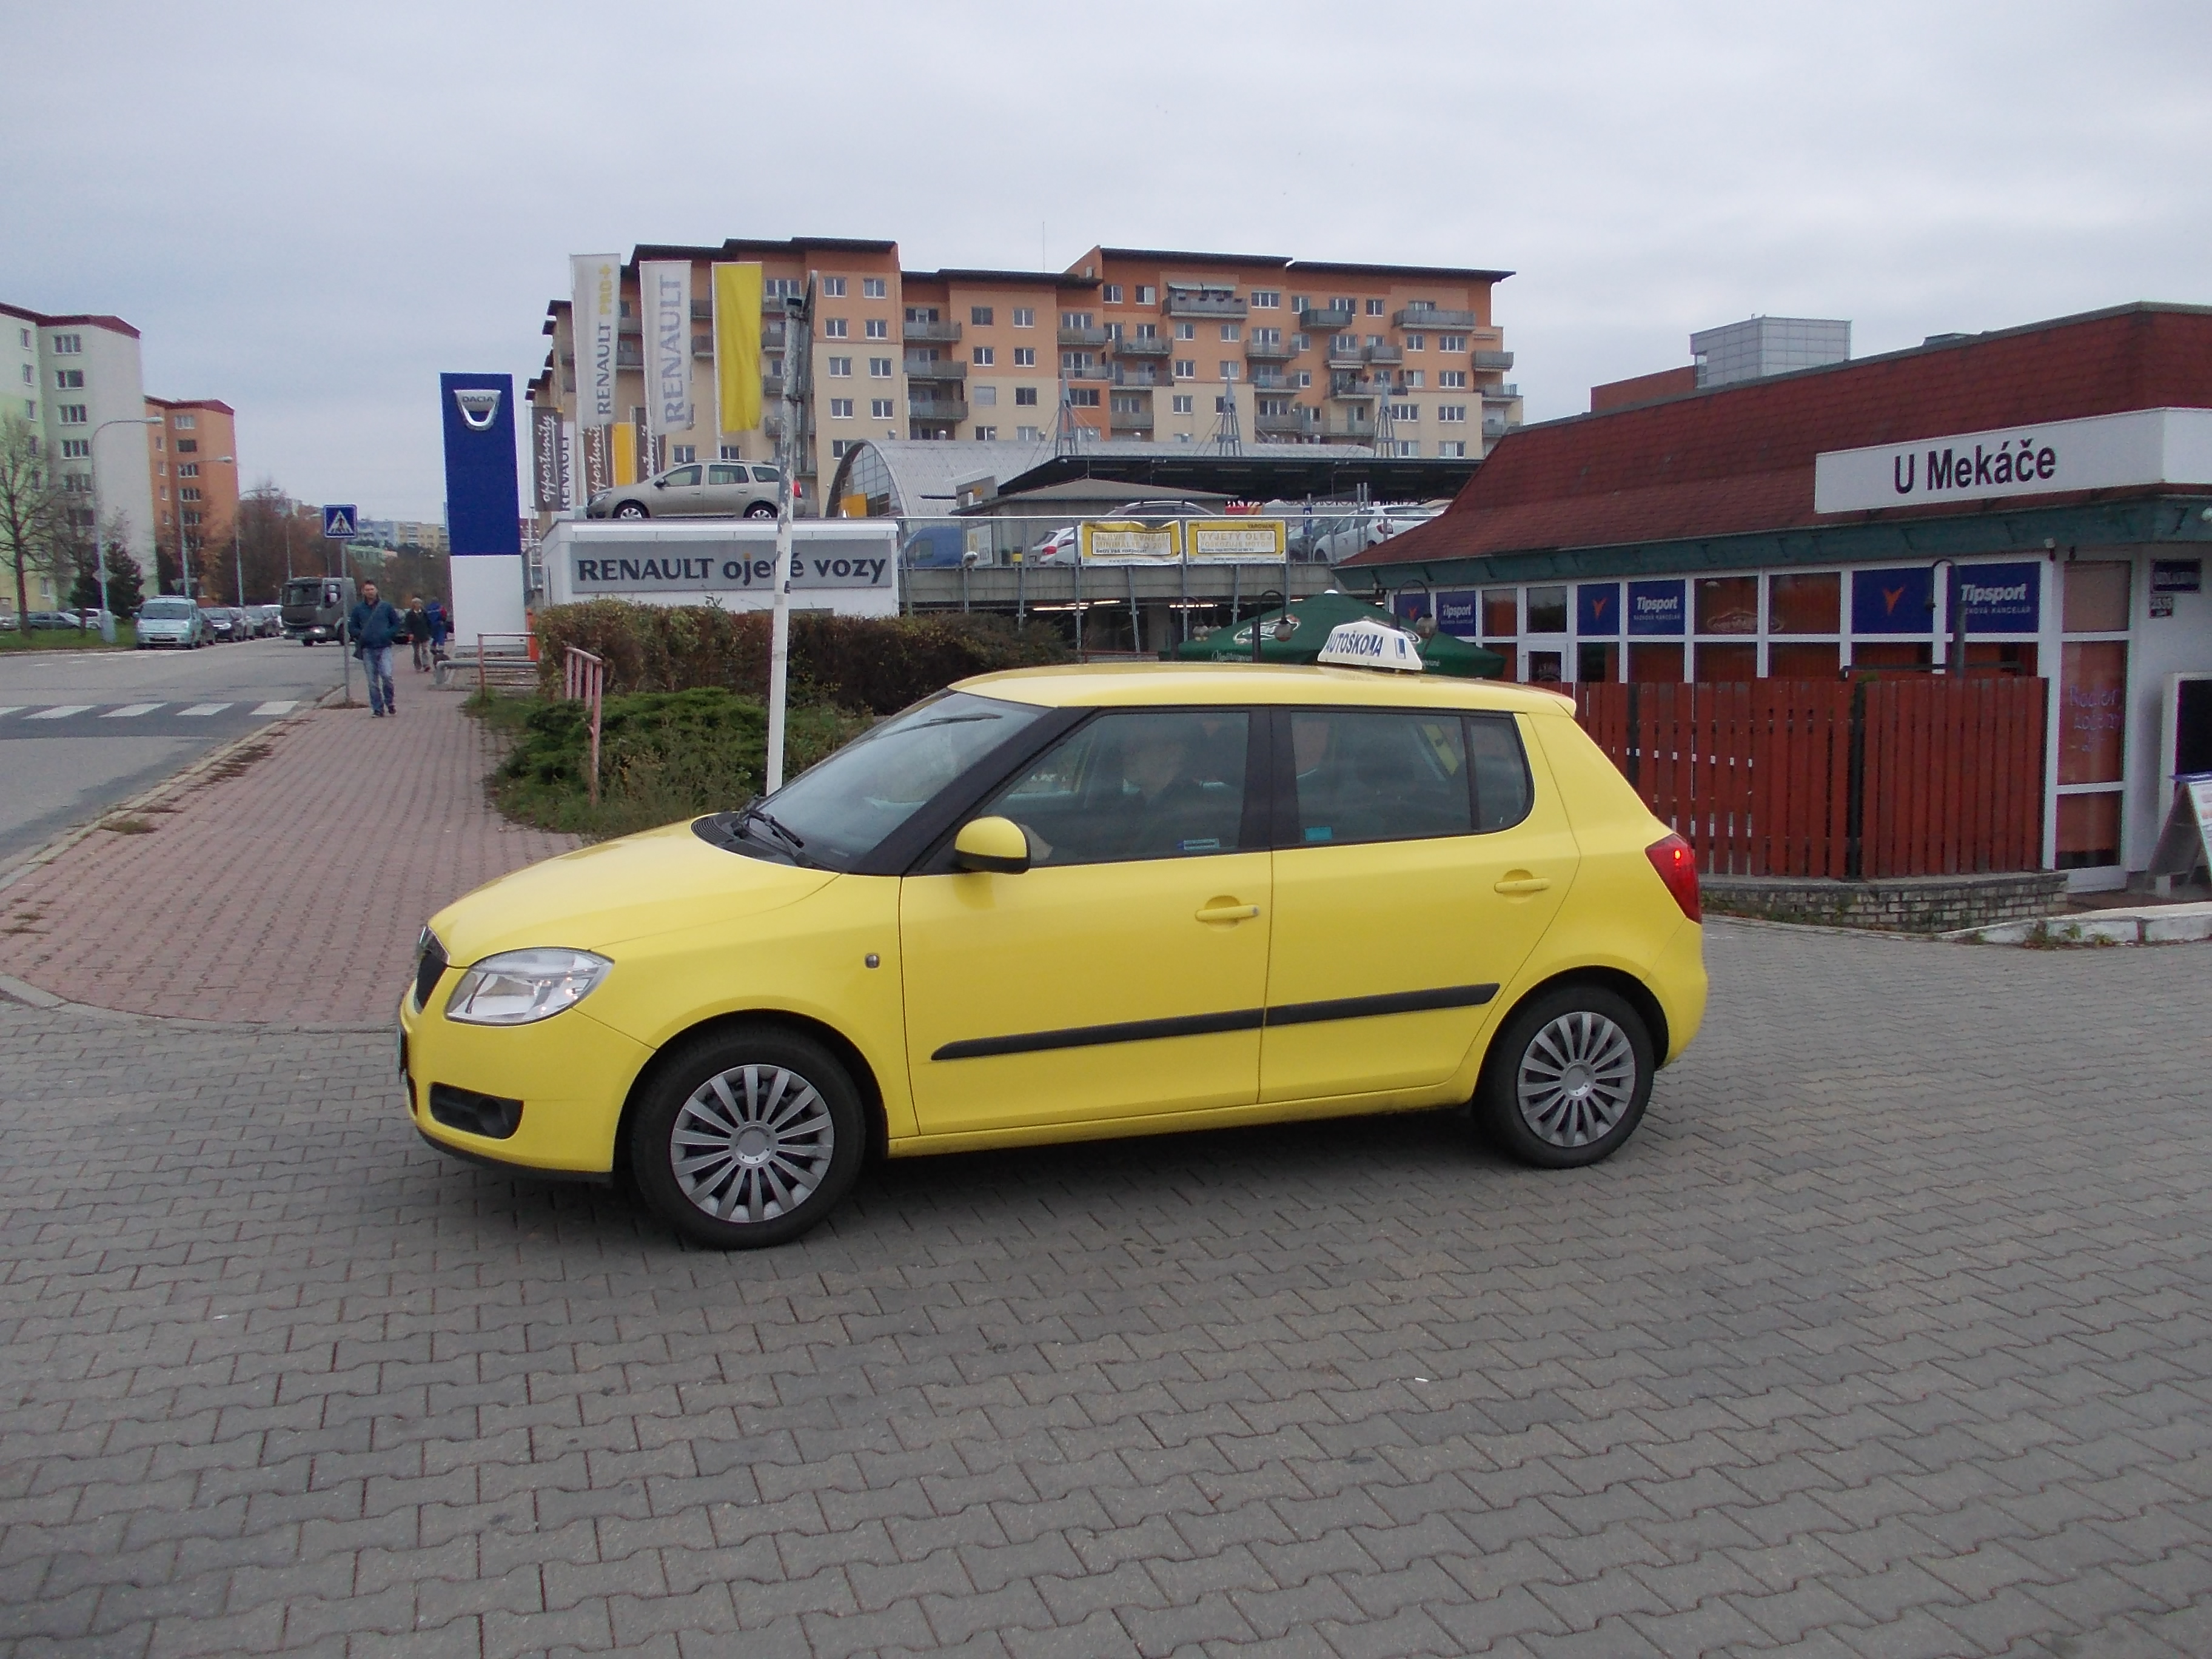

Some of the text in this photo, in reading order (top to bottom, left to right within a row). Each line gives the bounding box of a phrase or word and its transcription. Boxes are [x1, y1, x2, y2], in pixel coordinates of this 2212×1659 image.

[660, 275, 686, 424] RENAULT
[597, 321, 611, 415] RENAULT
[538, 415, 557, 503] opportunity
[1894, 438, 2056, 494] U Mekáče
[1245, 532, 1272, 540] OLEJ
[578, 552, 886, 585] RENAULT ojeé vozy
[1637, 596, 1678, 612] Tipsport
[1961, 583, 2026, 605] Tipsport
[1443, 604, 1471, 618] Tipsport
